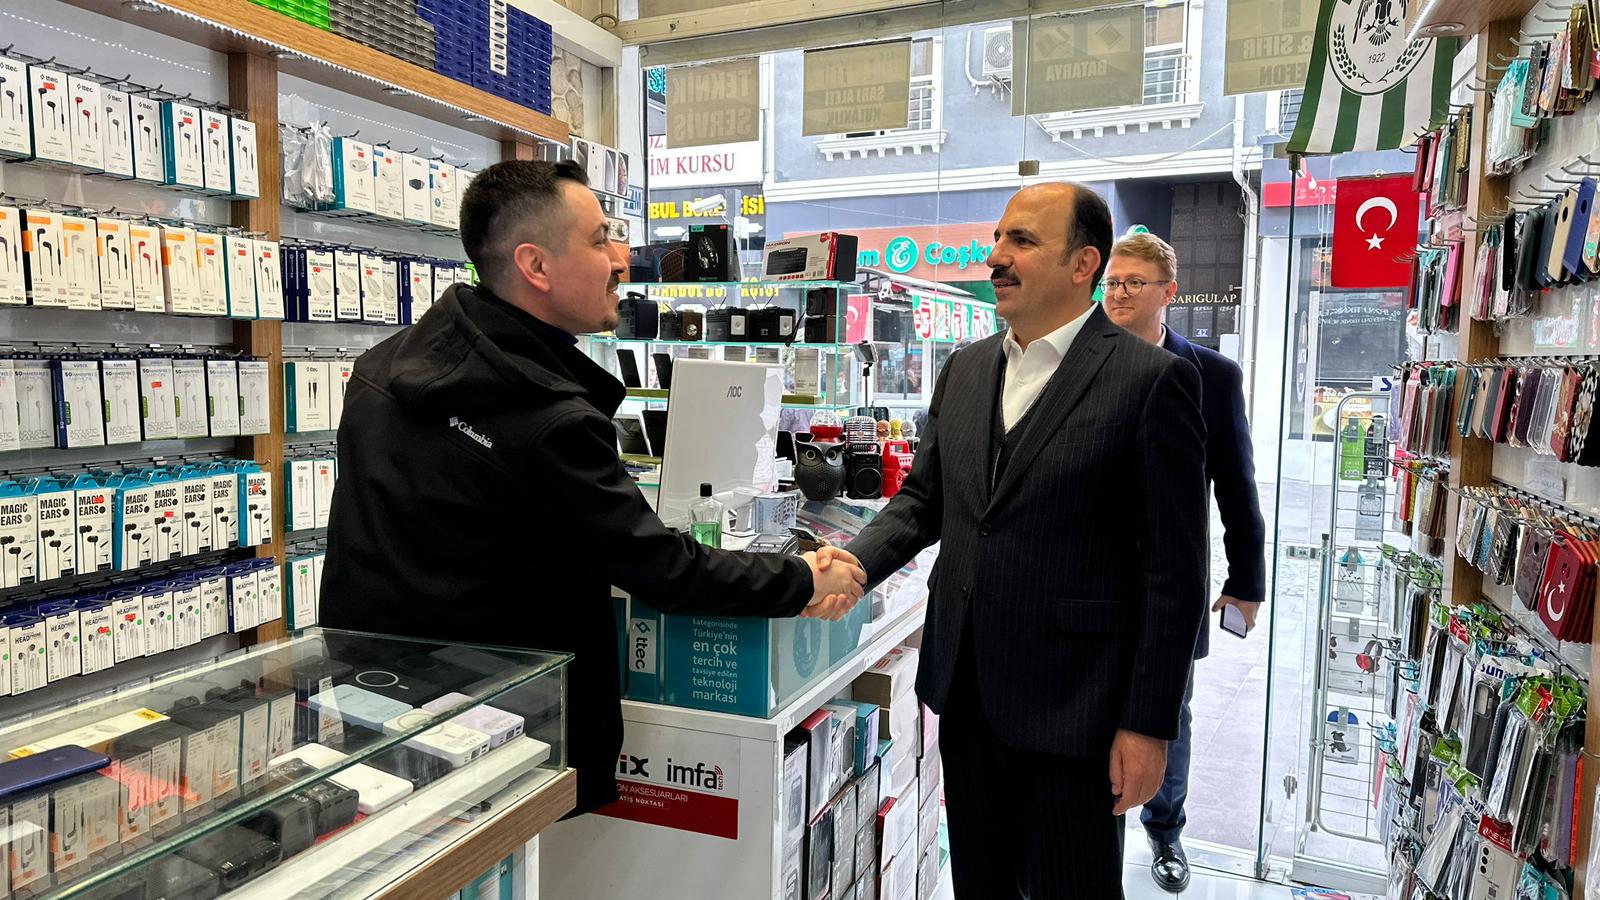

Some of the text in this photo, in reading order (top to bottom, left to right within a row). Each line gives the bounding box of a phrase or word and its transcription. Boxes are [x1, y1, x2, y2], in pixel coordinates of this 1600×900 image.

[1368, 52, 1386, 64] 1922
[676, 153, 735, 174] KURSU
[650, 202, 680, 220] BUL
[727, 386, 742, 398] AOC
[458, 422, 492, 448] Columbia
[184, 484, 206, 494] MAGIC
[213, 480, 232, 489] MAGIC
[126, 493, 147, 504] MAGIC
[155, 488, 176, 499] MAGIC
[184, 494, 201, 503] EARS
[213, 490, 228, 499] EARS
[40, 498, 66, 509] MAGIC
[79, 495, 104, 505] MAG
[155, 498, 172, 508] EARS
[1, 503, 27, 515] MAGIC
[40, 509, 61, 520] EARS
[79, 506, 99, 516] EARS
[126, 504, 143, 514] EARS
[0, 515, 22, 526] EARS
[51, 620, 75, 632] HEADPHONE
[85, 615, 109, 626] HEADPHONE
[15, 632, 41, 644] HEADPHONE
[693, 628, 737, 641] Türkiye'nin
[636, 636, 648, 670] ttec
[693, 642, 737, 657] en çok
[693, 656, 737, 669] tercih ve
[692, 667, 716, 676] tavsiye
[692, 677, 737, 692] teknoloji
[692, 690, 737, 703] markası
[667, 758, 717, 790] imfa
[630, 786, 688, 802] AKSESUARLARI
[636, 798, 664, 807] NOKTASI
